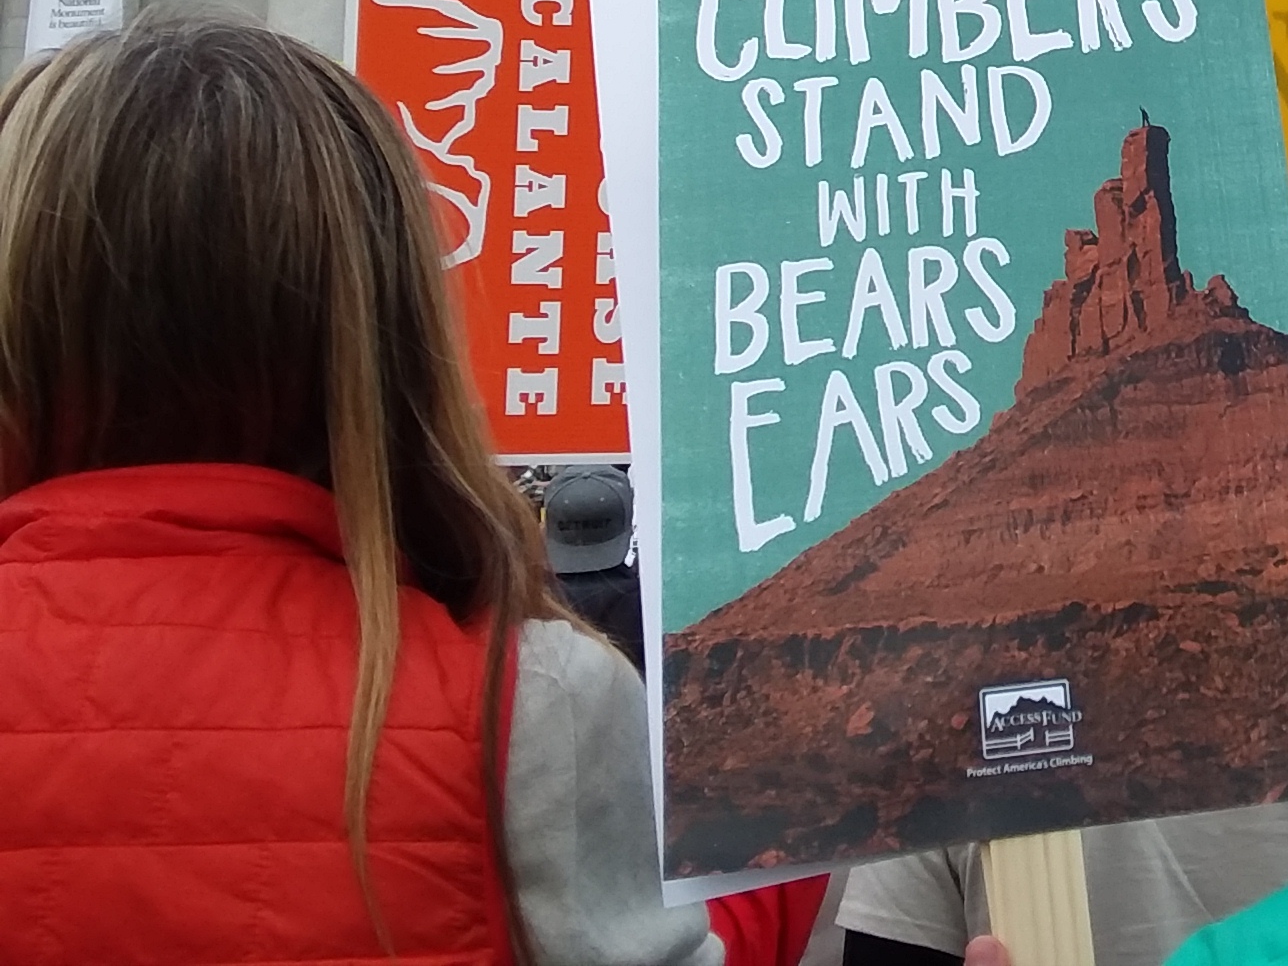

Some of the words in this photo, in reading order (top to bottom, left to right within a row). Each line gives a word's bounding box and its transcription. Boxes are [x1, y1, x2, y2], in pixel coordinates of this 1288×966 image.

[735, 64, 1053, 169] STAND
[817, 167, 981, 247] WITH
[714, 236, 1017, 375] BEARS
[729, 350, 981, 553] EARS
[966, 765, 1001, 778] Protect
[1003, 759, 1048, 774] America's
[1049, 754, 1093, 768] Climbing
